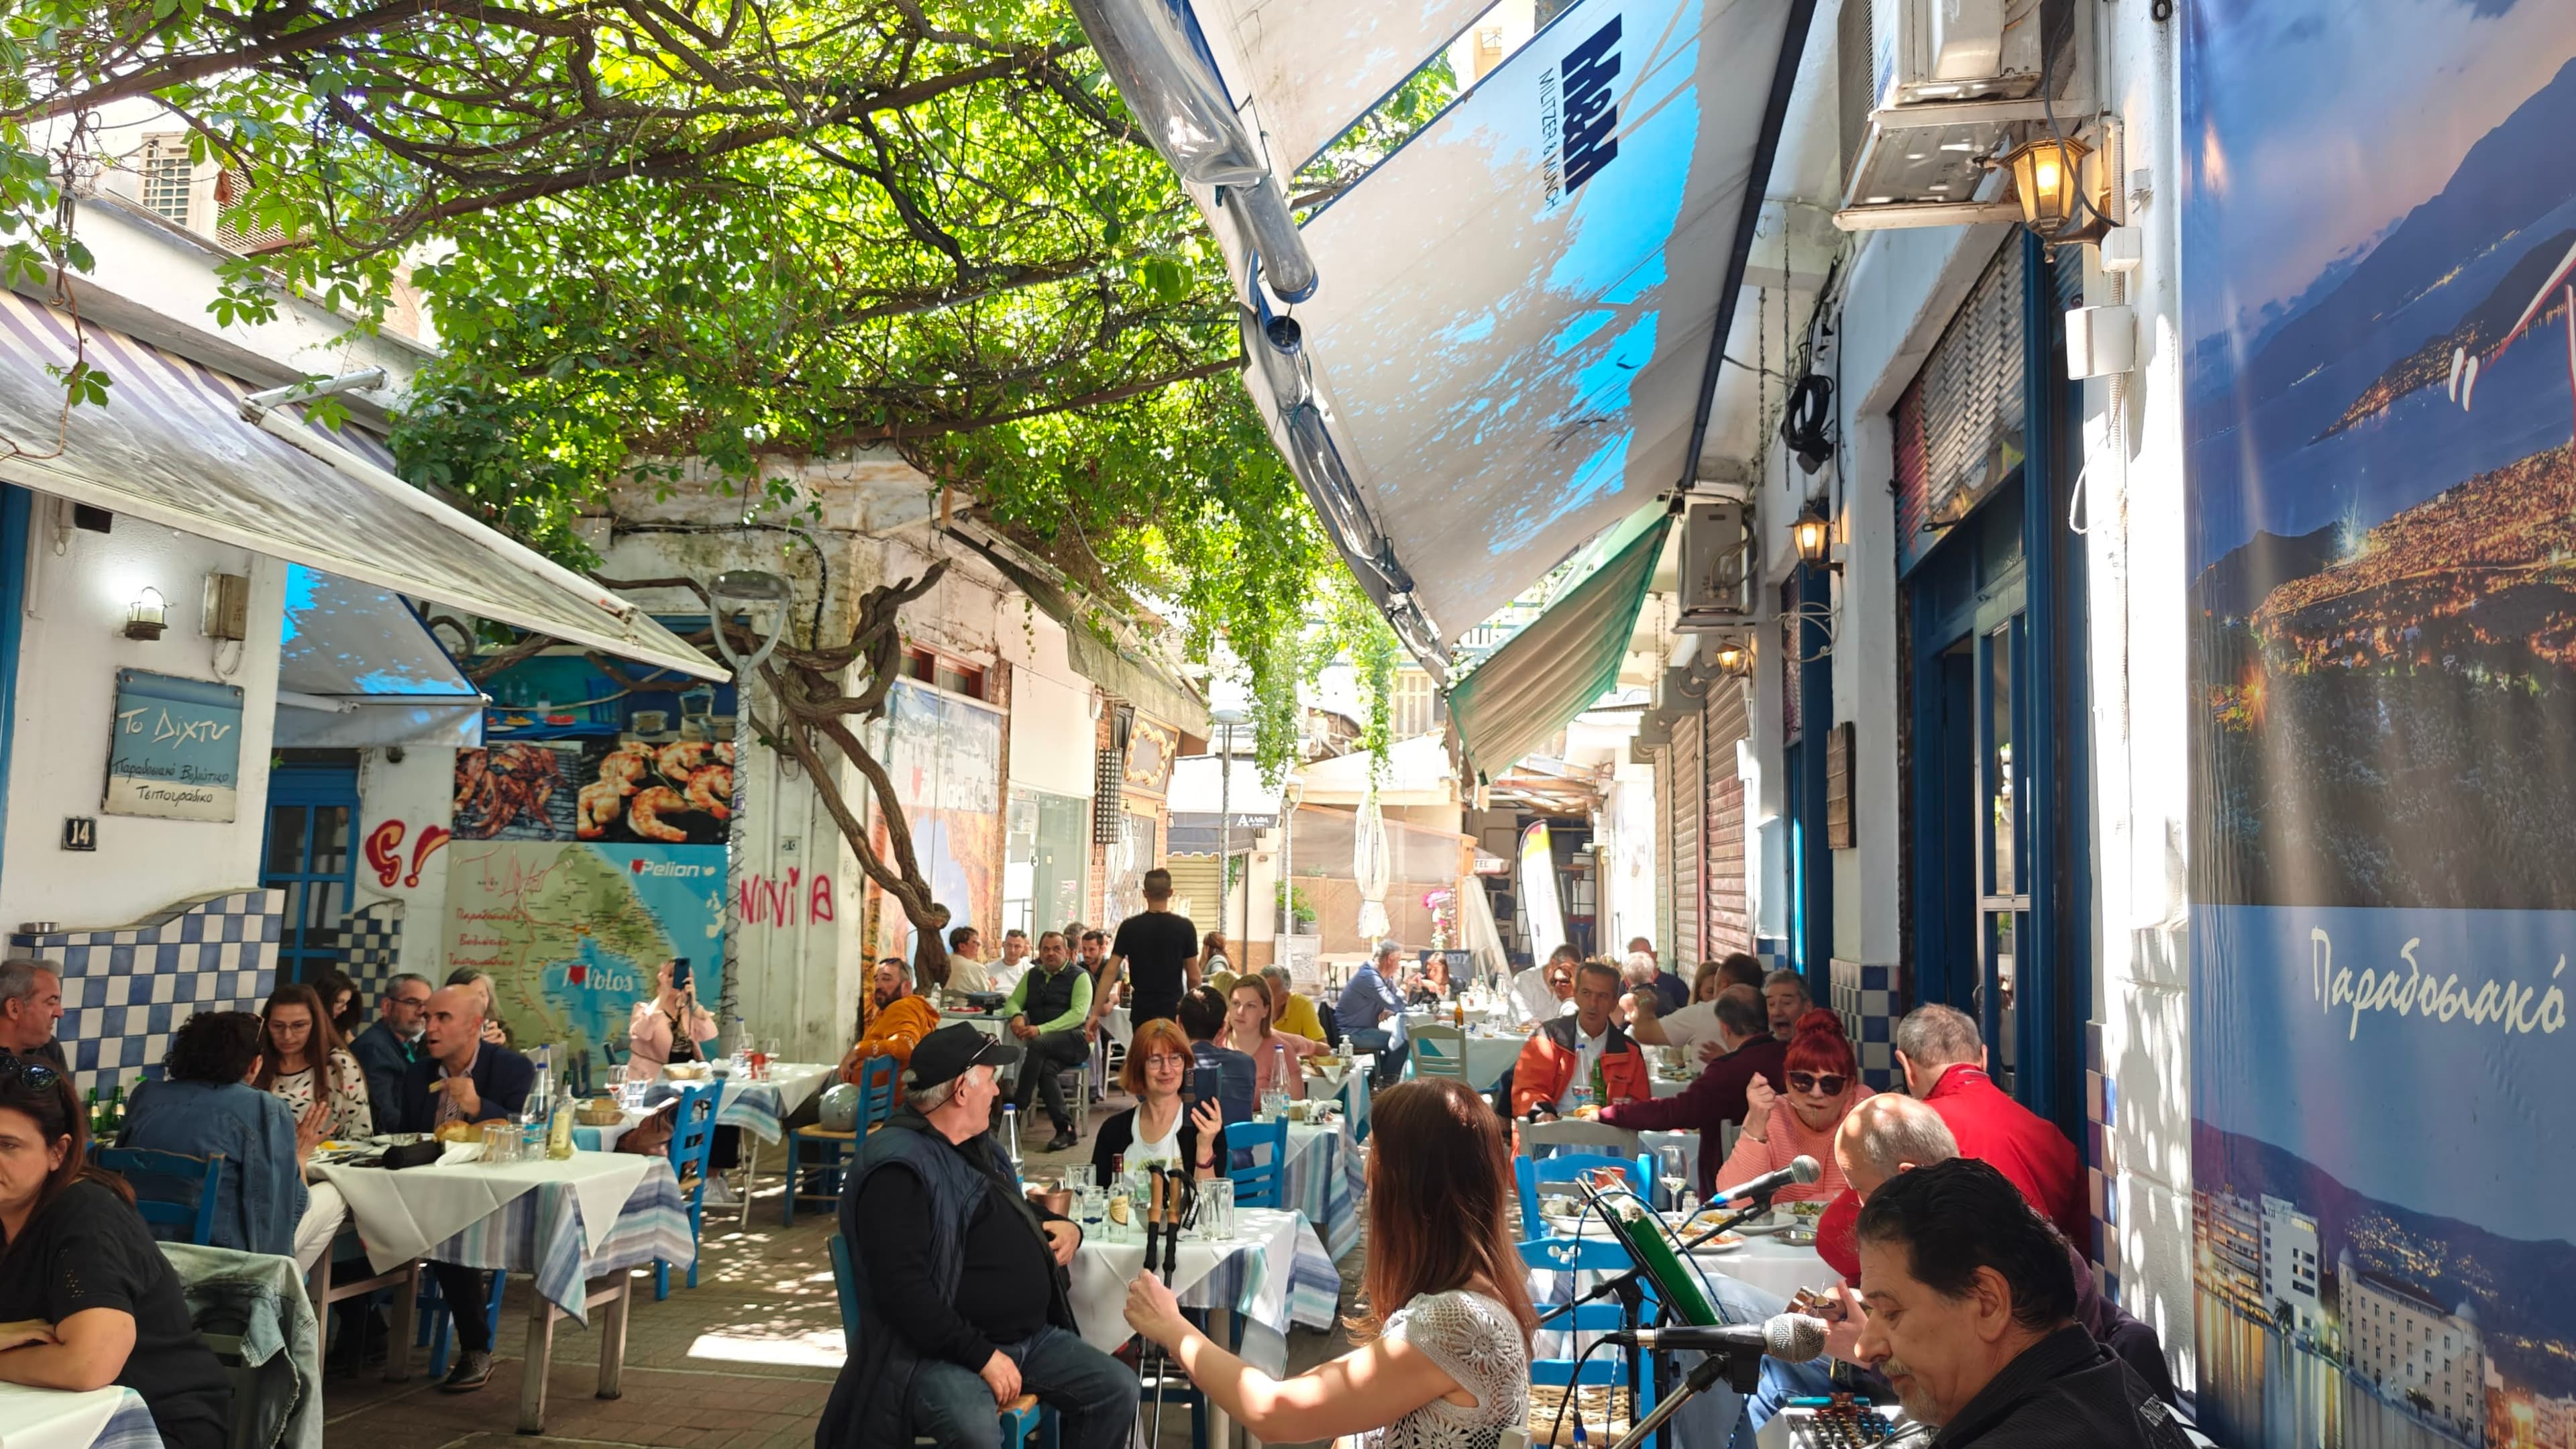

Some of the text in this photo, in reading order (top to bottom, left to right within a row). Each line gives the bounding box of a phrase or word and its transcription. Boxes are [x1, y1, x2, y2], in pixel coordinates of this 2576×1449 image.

[1538, 67, 1559, 211] MILITZER & MÜNCH
[119, 707, 149, 735] Το
[70, 820, 90, 845] 14
[641, 861, 700, 877] Pelion
[584, 964, 633, 991] Volos
[2310, 924, 2567, 1041] Παραδοσιακό
